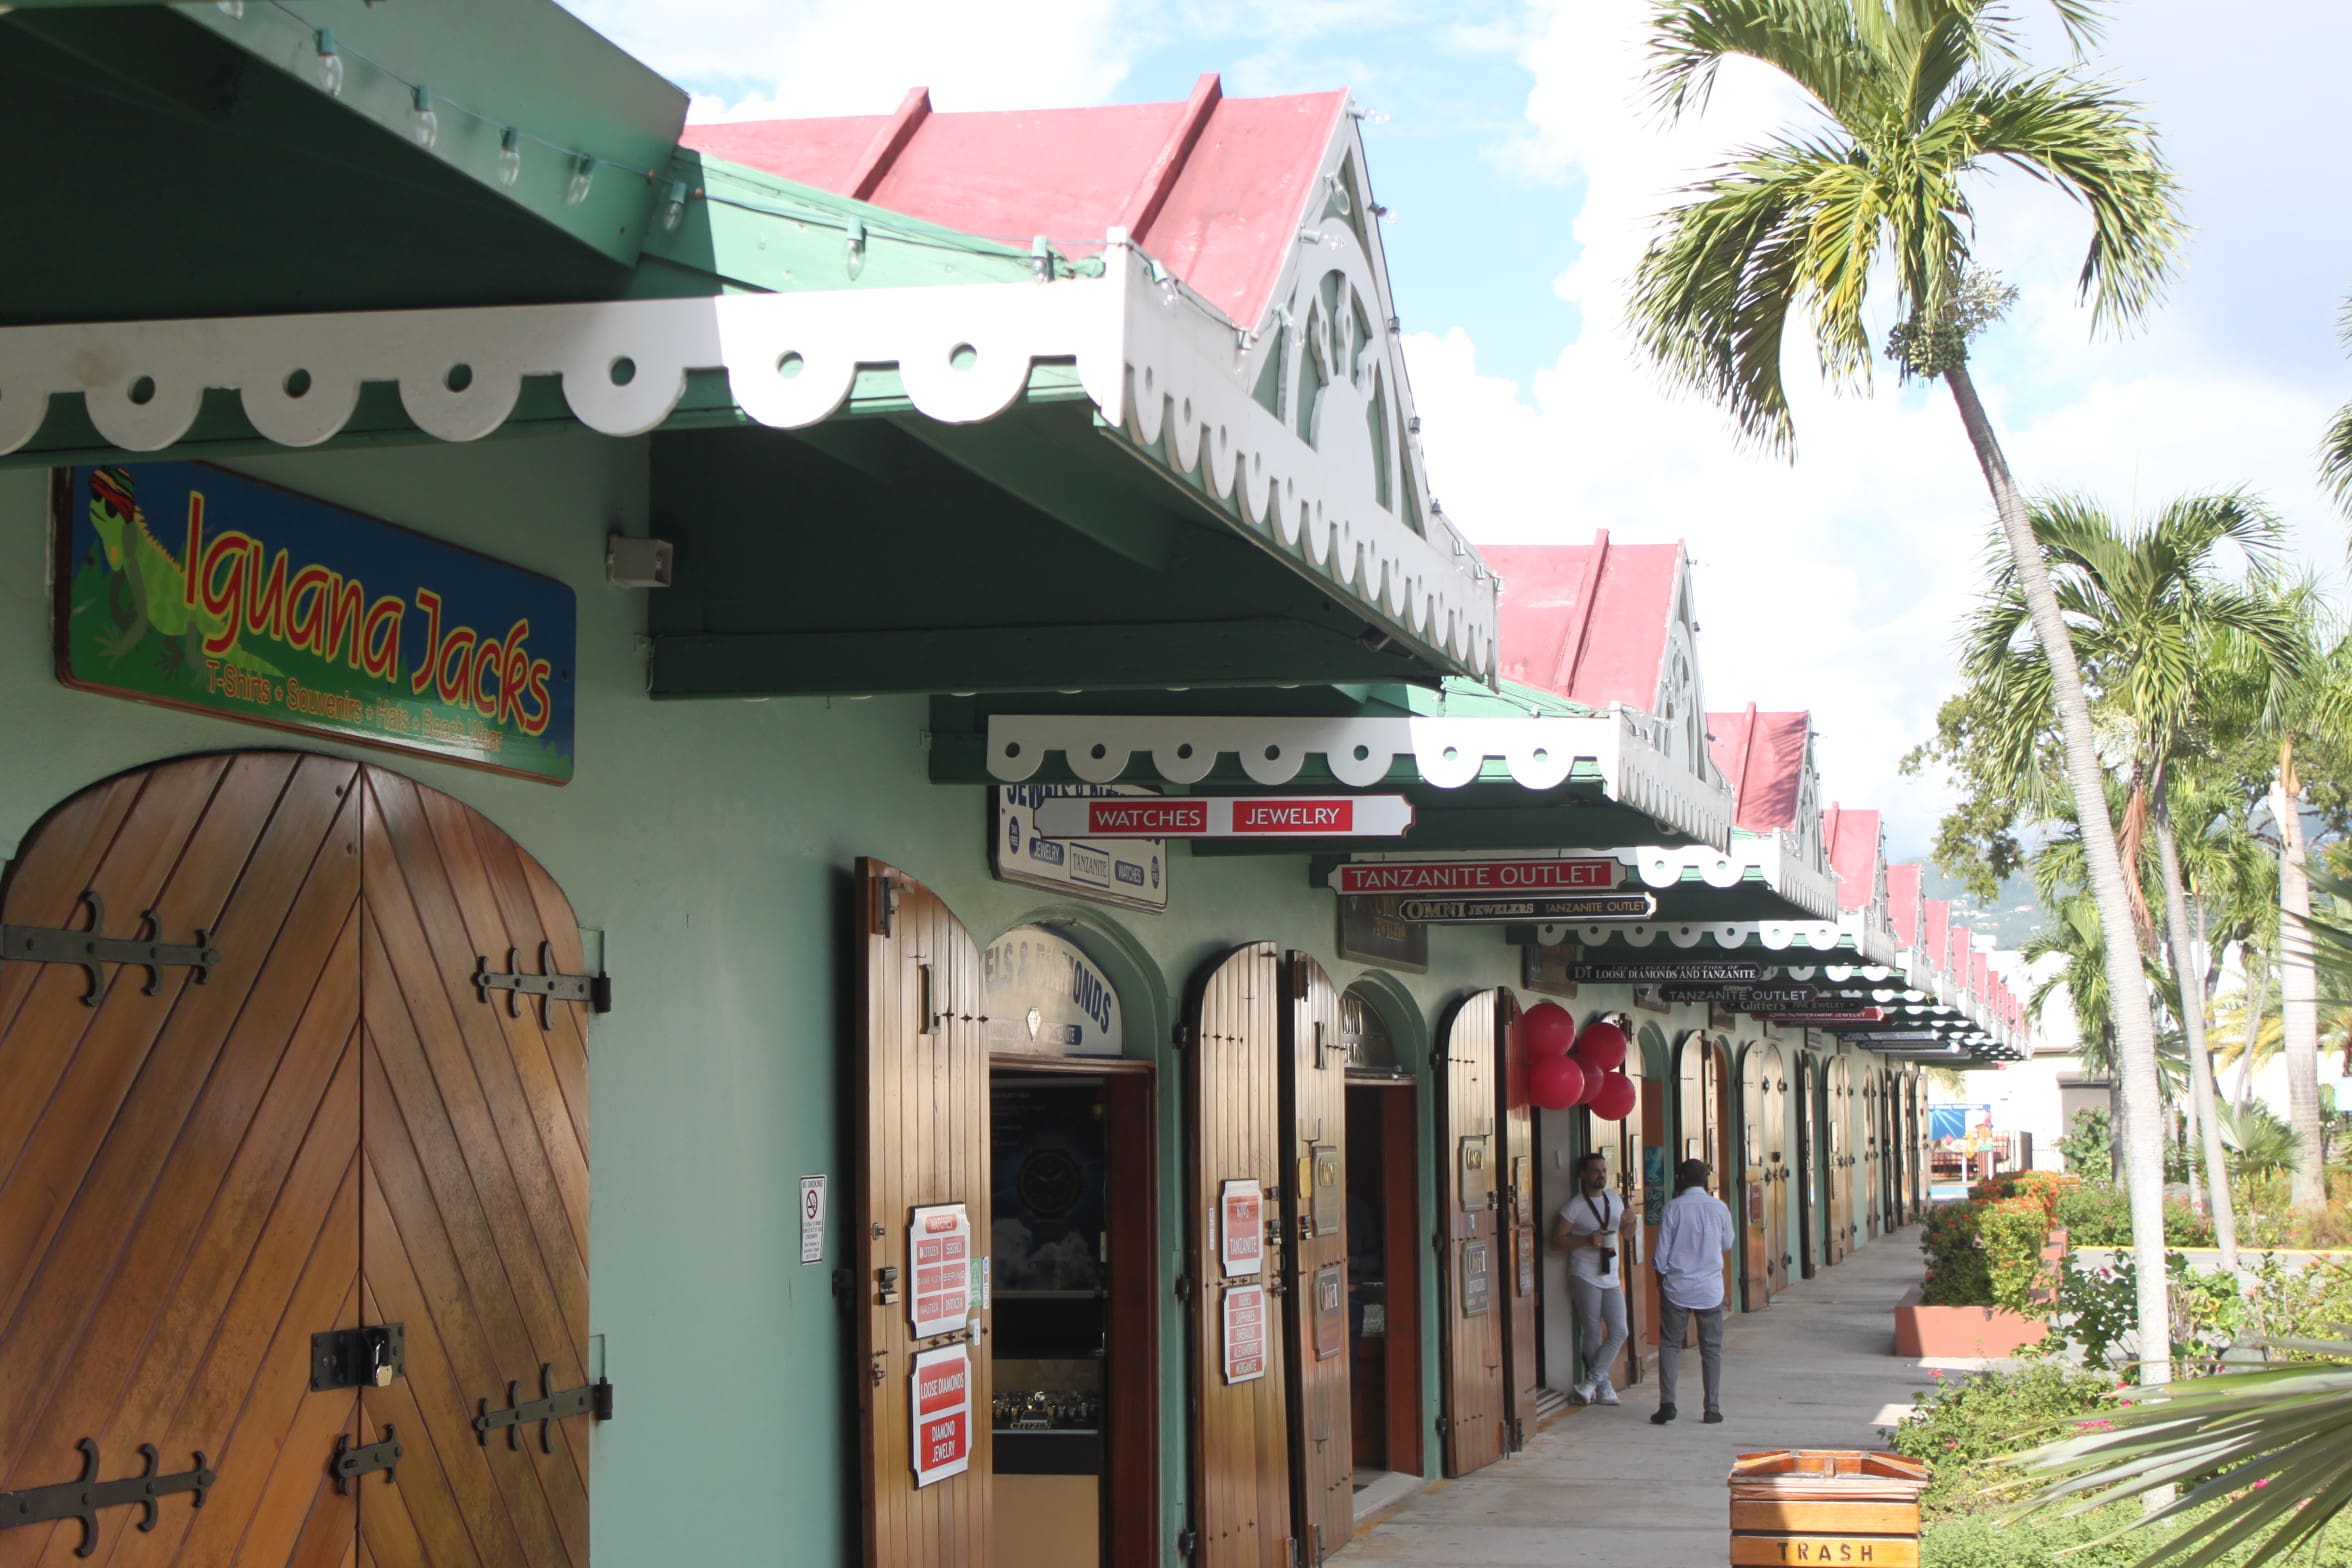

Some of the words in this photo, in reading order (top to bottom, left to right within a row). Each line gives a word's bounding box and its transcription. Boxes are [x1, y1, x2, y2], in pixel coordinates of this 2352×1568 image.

[184, 490, 405, 684] Iguana
[411, 587, 551, 735] Jacks
[207, 660, 271, 704] T-Shirts
[287, 677, 362, 724] Souvenirs
[376, 697, 409, 733] Hats
[422, 707, 466, 745] Beach
[1007, 785, 1074, 809] JEW
[1095, 809, 1200, 827] WATCHES
[1245, 807, 1341, 826] JEWELRY
[1033, 842, 1061, 863] JEWELRY
[1073, 853, 1108, 878] TANZANITE
[1118, 864, 1142, 884] WATCHES
[1351, 867, 1490, 888] TANZANITE
[1500, 865, 1602, 886] OUTLET
[1407, 902, 1467, 918] OMNI
[1468, 903, 1534, 915] JEWELERS
[1545, 902, 1603, 913] TANZANITE
[1607, 901, 1646, 912] OUTLET
[1596, 970, 1626, 979] LOOSE
[1628, 970, 1678, 979] DIAMONDS
[1679, 970, 1700, 979] AND
[1702, 969, 1756, 979] TANZANITE
[1036, 943, 1112, 1035] DMONDS
[1669, 991, 1748, 1001] TANZANITE
[1752, 990, 1808, 1001] OUTLET
[1230, 1237, 1257, 1255] TANZANITE
[920, 1380, 938, 1399] LOOSE
[938, 1373, 964, 1394] DIAMONDS
[931, 1420, 955, 1442] DIAMOND
[1010, 1422, 1051, 1430] CITIZEN
[932, 1441, 956, 1463] JEWELRY
[1776, 1542, 1873, 1562] TRASH
